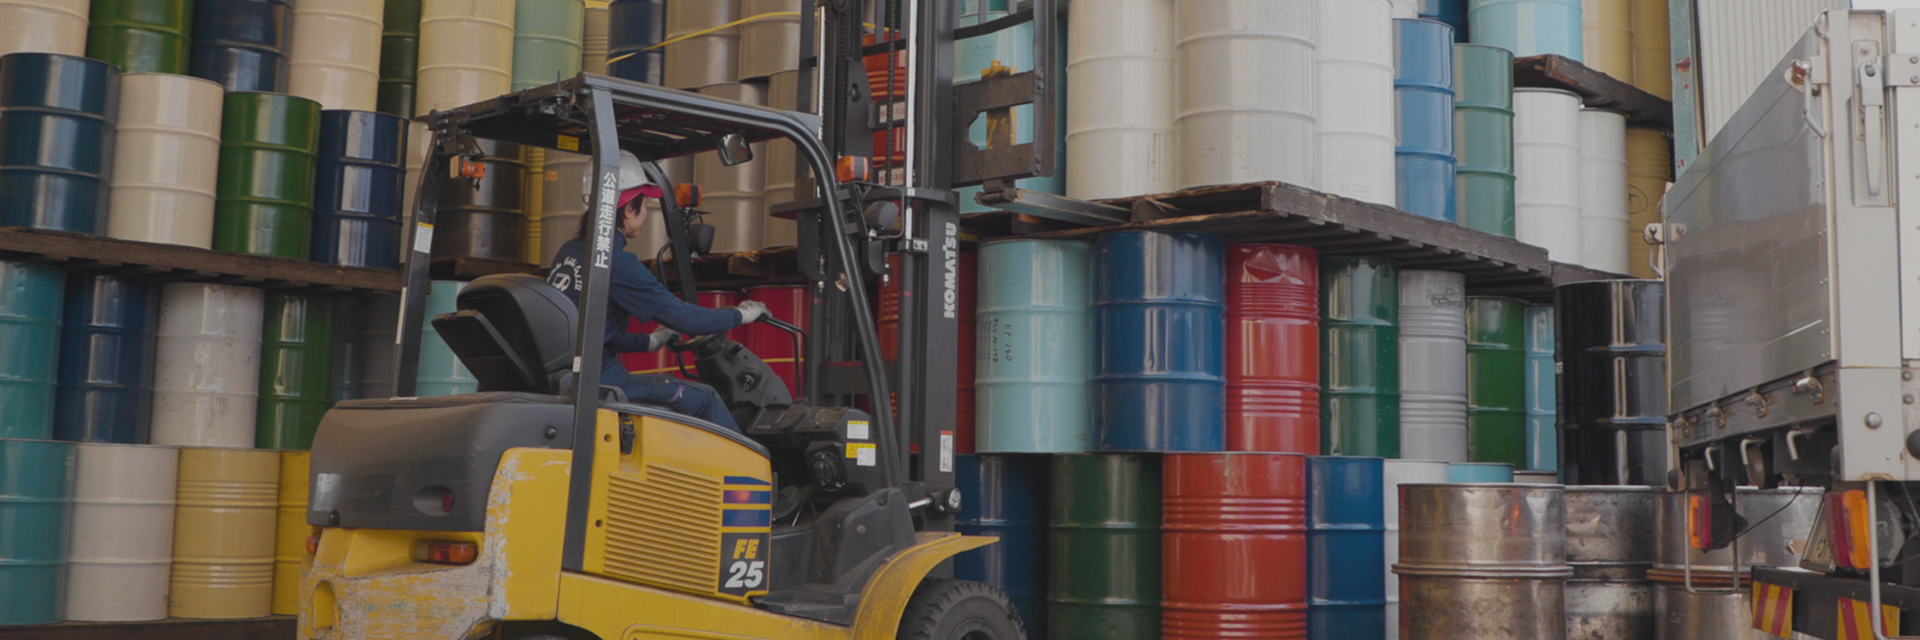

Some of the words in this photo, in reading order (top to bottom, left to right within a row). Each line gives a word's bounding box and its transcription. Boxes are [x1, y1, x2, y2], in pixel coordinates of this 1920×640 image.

[595, 172, 616, 268] 公道走行禁止
[942, 222, 957, 318] KOMATSU
[724, 561, 765, 588] 25
[732, 538, 760, 559] FE
